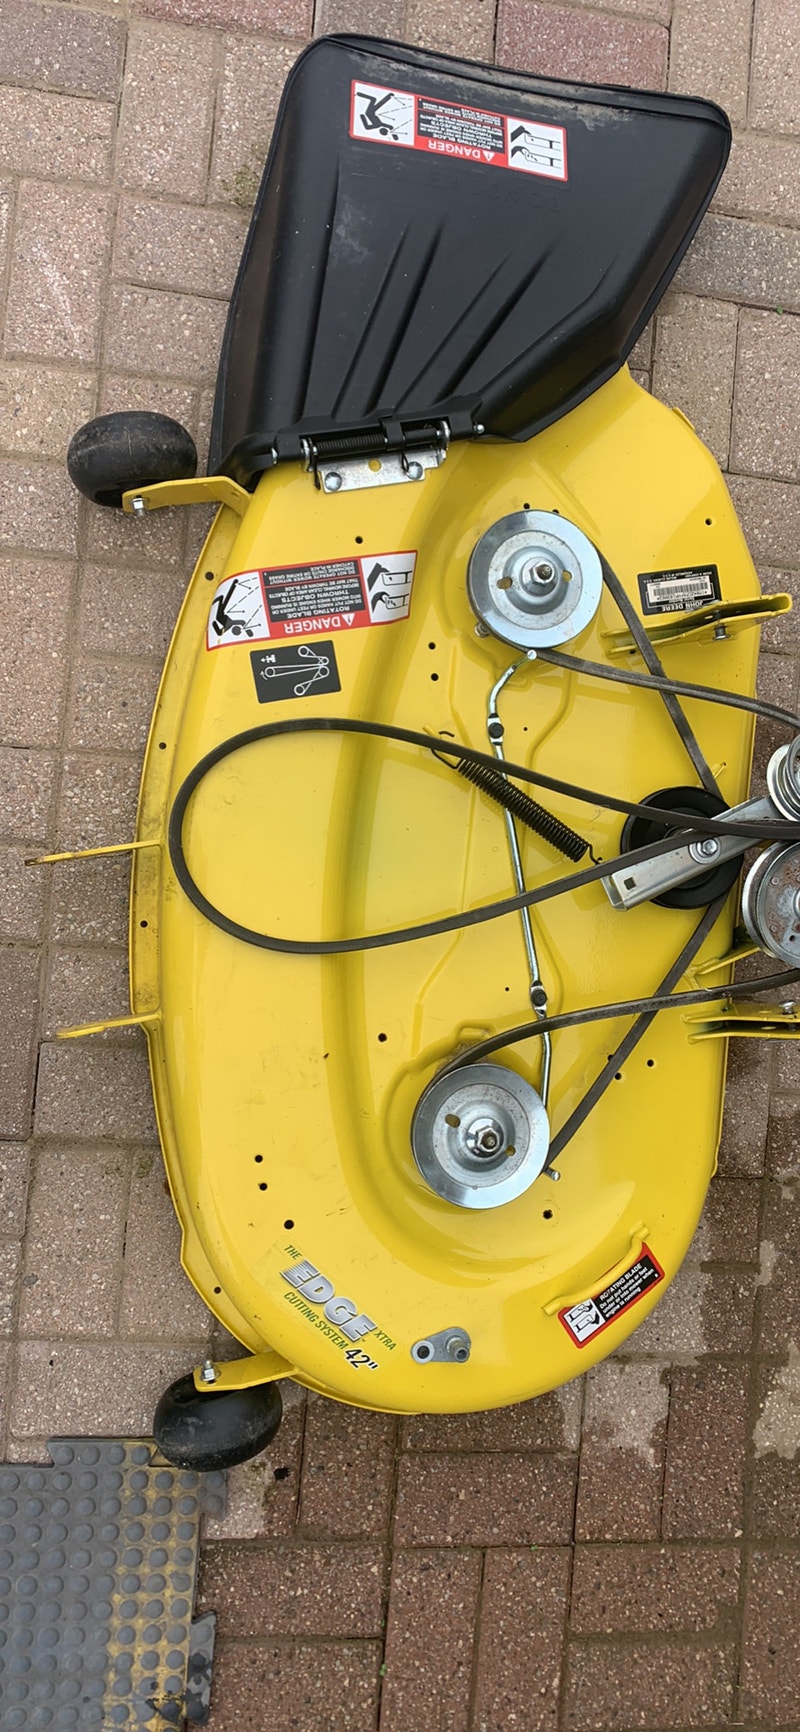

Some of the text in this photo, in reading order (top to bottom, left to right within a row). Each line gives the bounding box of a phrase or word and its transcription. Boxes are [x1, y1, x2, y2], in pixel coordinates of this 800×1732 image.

[427, 139, 481, 158] DANGER
[432, 132, 491, 149] ROTATING BLADE
[280, 588, 349, 603] THROWN OBJECTS
[660, 600, 703, 611] JOHN DEERE
[286, 605, 349, 619] ROTATING BLADE
[283, 615, 341, 634] DANGER
[598, 1262, 642, 1301] ROTATING BLADE
[598, 1300, 607, 1309] Do
[605, 1294, 614, 1304] not
[612, 1288, 622, 1297] put
[620, 1277, 635, 1291] hands
[637, 1266, 648, 1276] feet
[280, 1244, 396, 1350] THE EDGE XTRA
[604, 1303, 621, 1318] engine
[623, 1285, 642, 1303] running
[284, 1291, 348, 1350] CUTTING SYSTEM
[345, 1347, 378, 1370] 42"
